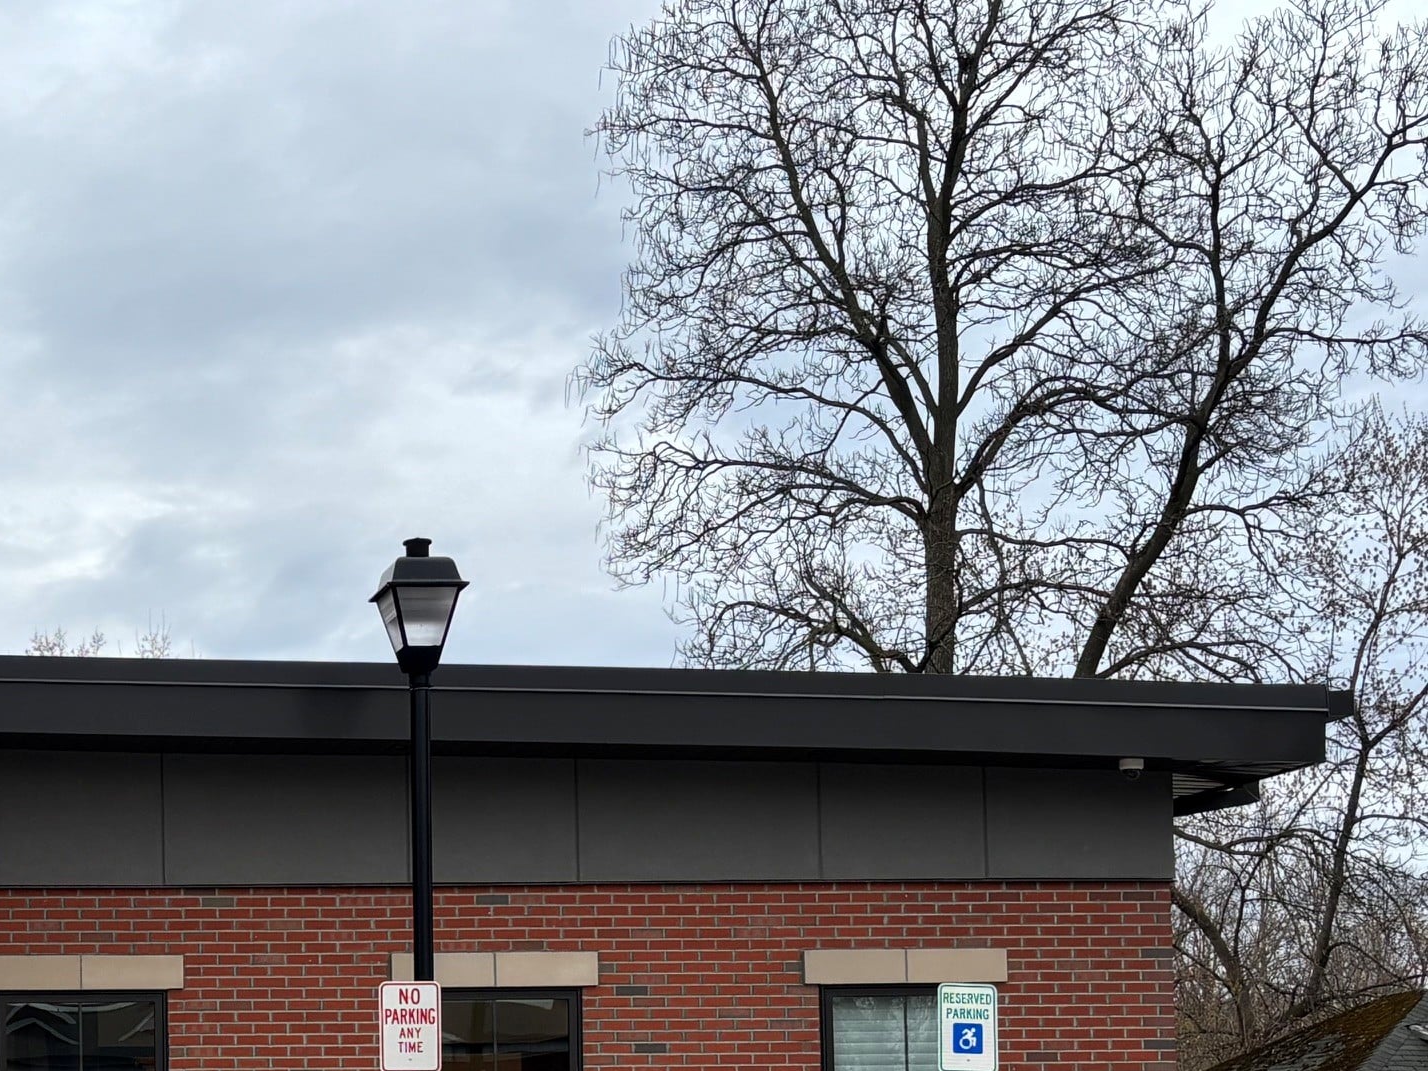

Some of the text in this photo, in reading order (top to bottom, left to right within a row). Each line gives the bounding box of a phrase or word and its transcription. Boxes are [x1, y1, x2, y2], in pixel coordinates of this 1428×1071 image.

[399, 988, 421, 1005] NO
[943, 992, 992, 1005] RESERVED
[384, 1008, 436, 1025] PARKING
[946, 1008, 990, 1020] PARKING
[399, 1027, 422, 1039] ANY
[398, 1041, 424, 1053] TIME
